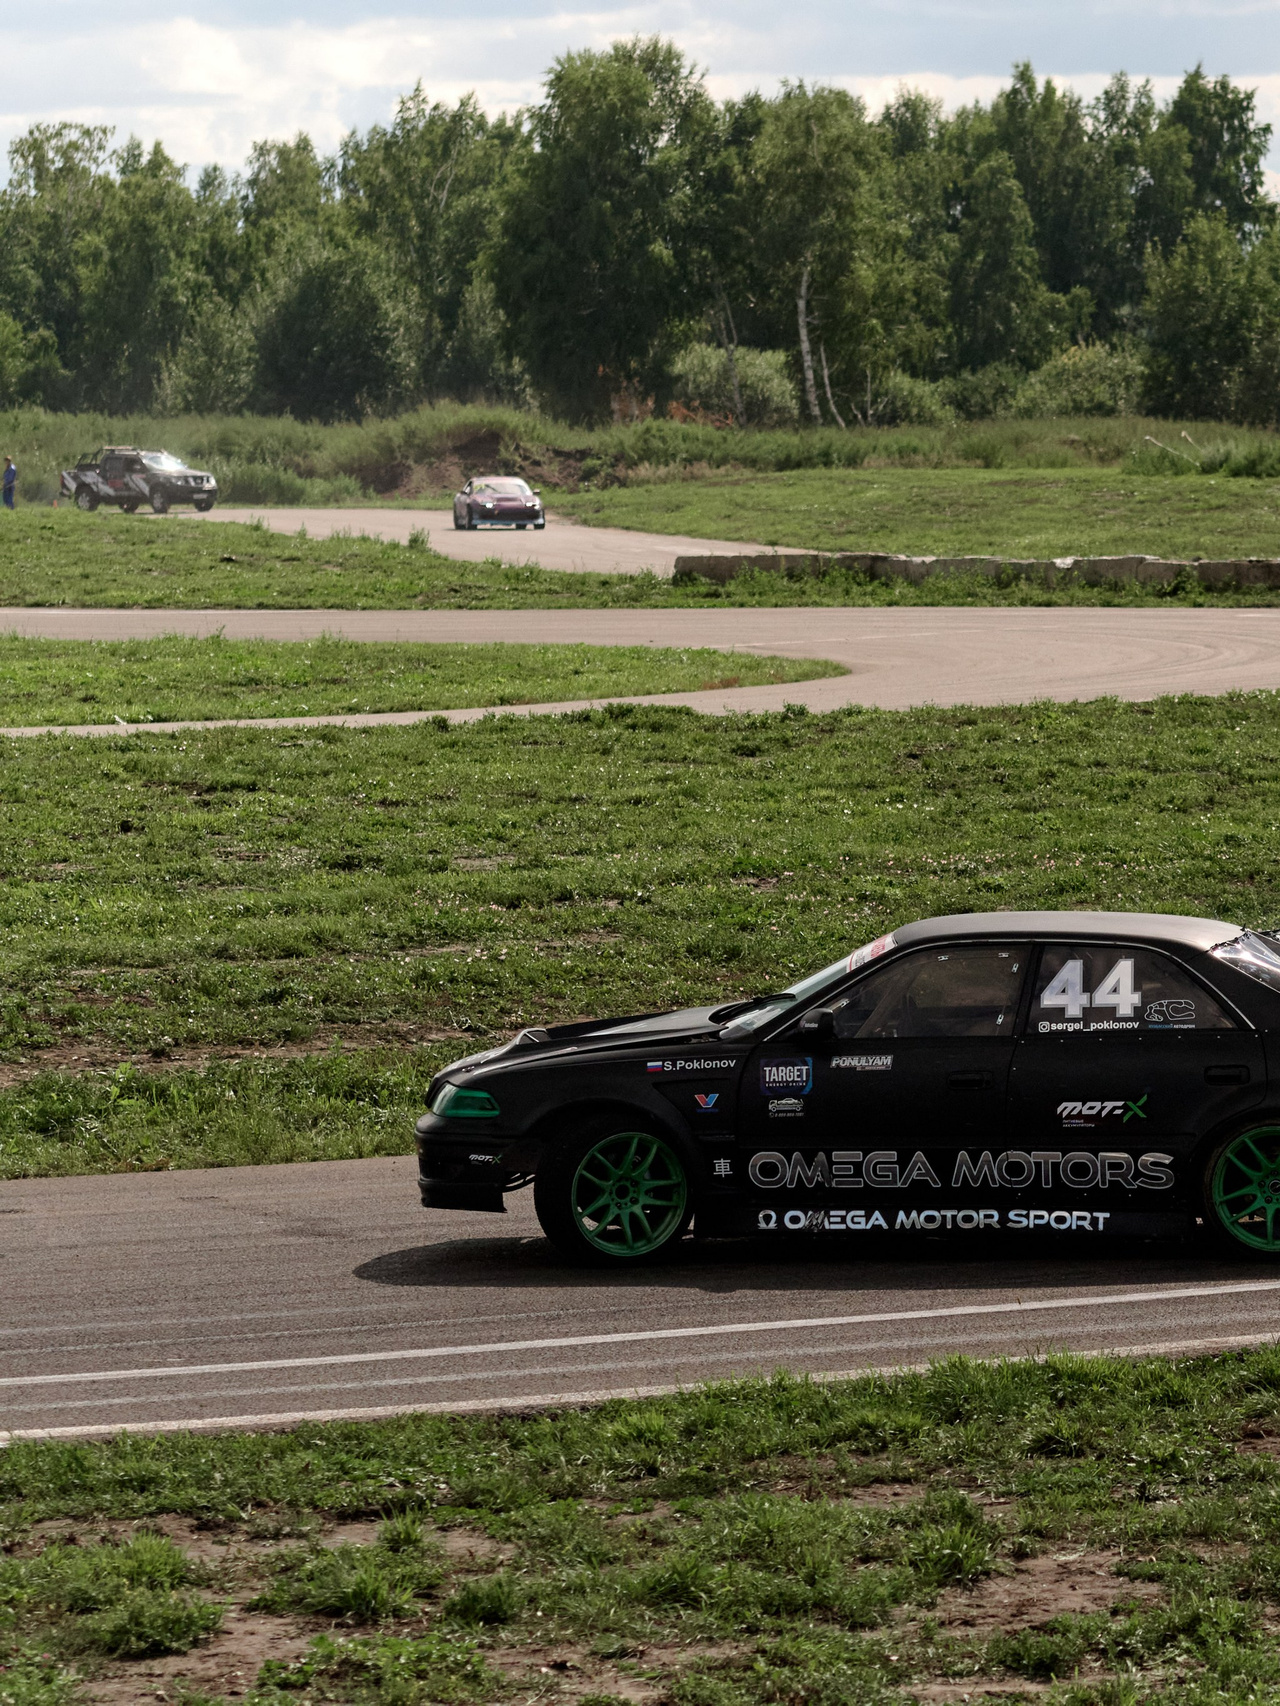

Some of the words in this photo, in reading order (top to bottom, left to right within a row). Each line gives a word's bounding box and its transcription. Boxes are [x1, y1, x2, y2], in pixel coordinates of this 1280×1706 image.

[1040, 958, 1142, 1018] 44
[1051, 1021, 1140, 1032] sergei_poklonov
[663, 1059, 736, 1071] S.Poklonov
[831, 1056, 892, 1068] PONULYAM
[764, 1066, 810, 1082] TARGET
[713, 1158, 733, 1178] 車
[749, 1151, 942, 1188] OMEGA
[952, 1151, 1175, 1189] MOTORS
[784, 1210, 889, 1231] OMEGA
[895, 1210, 1001, 1230] MOTOR
[1007, 1210, 1111, 1231] SPORT
